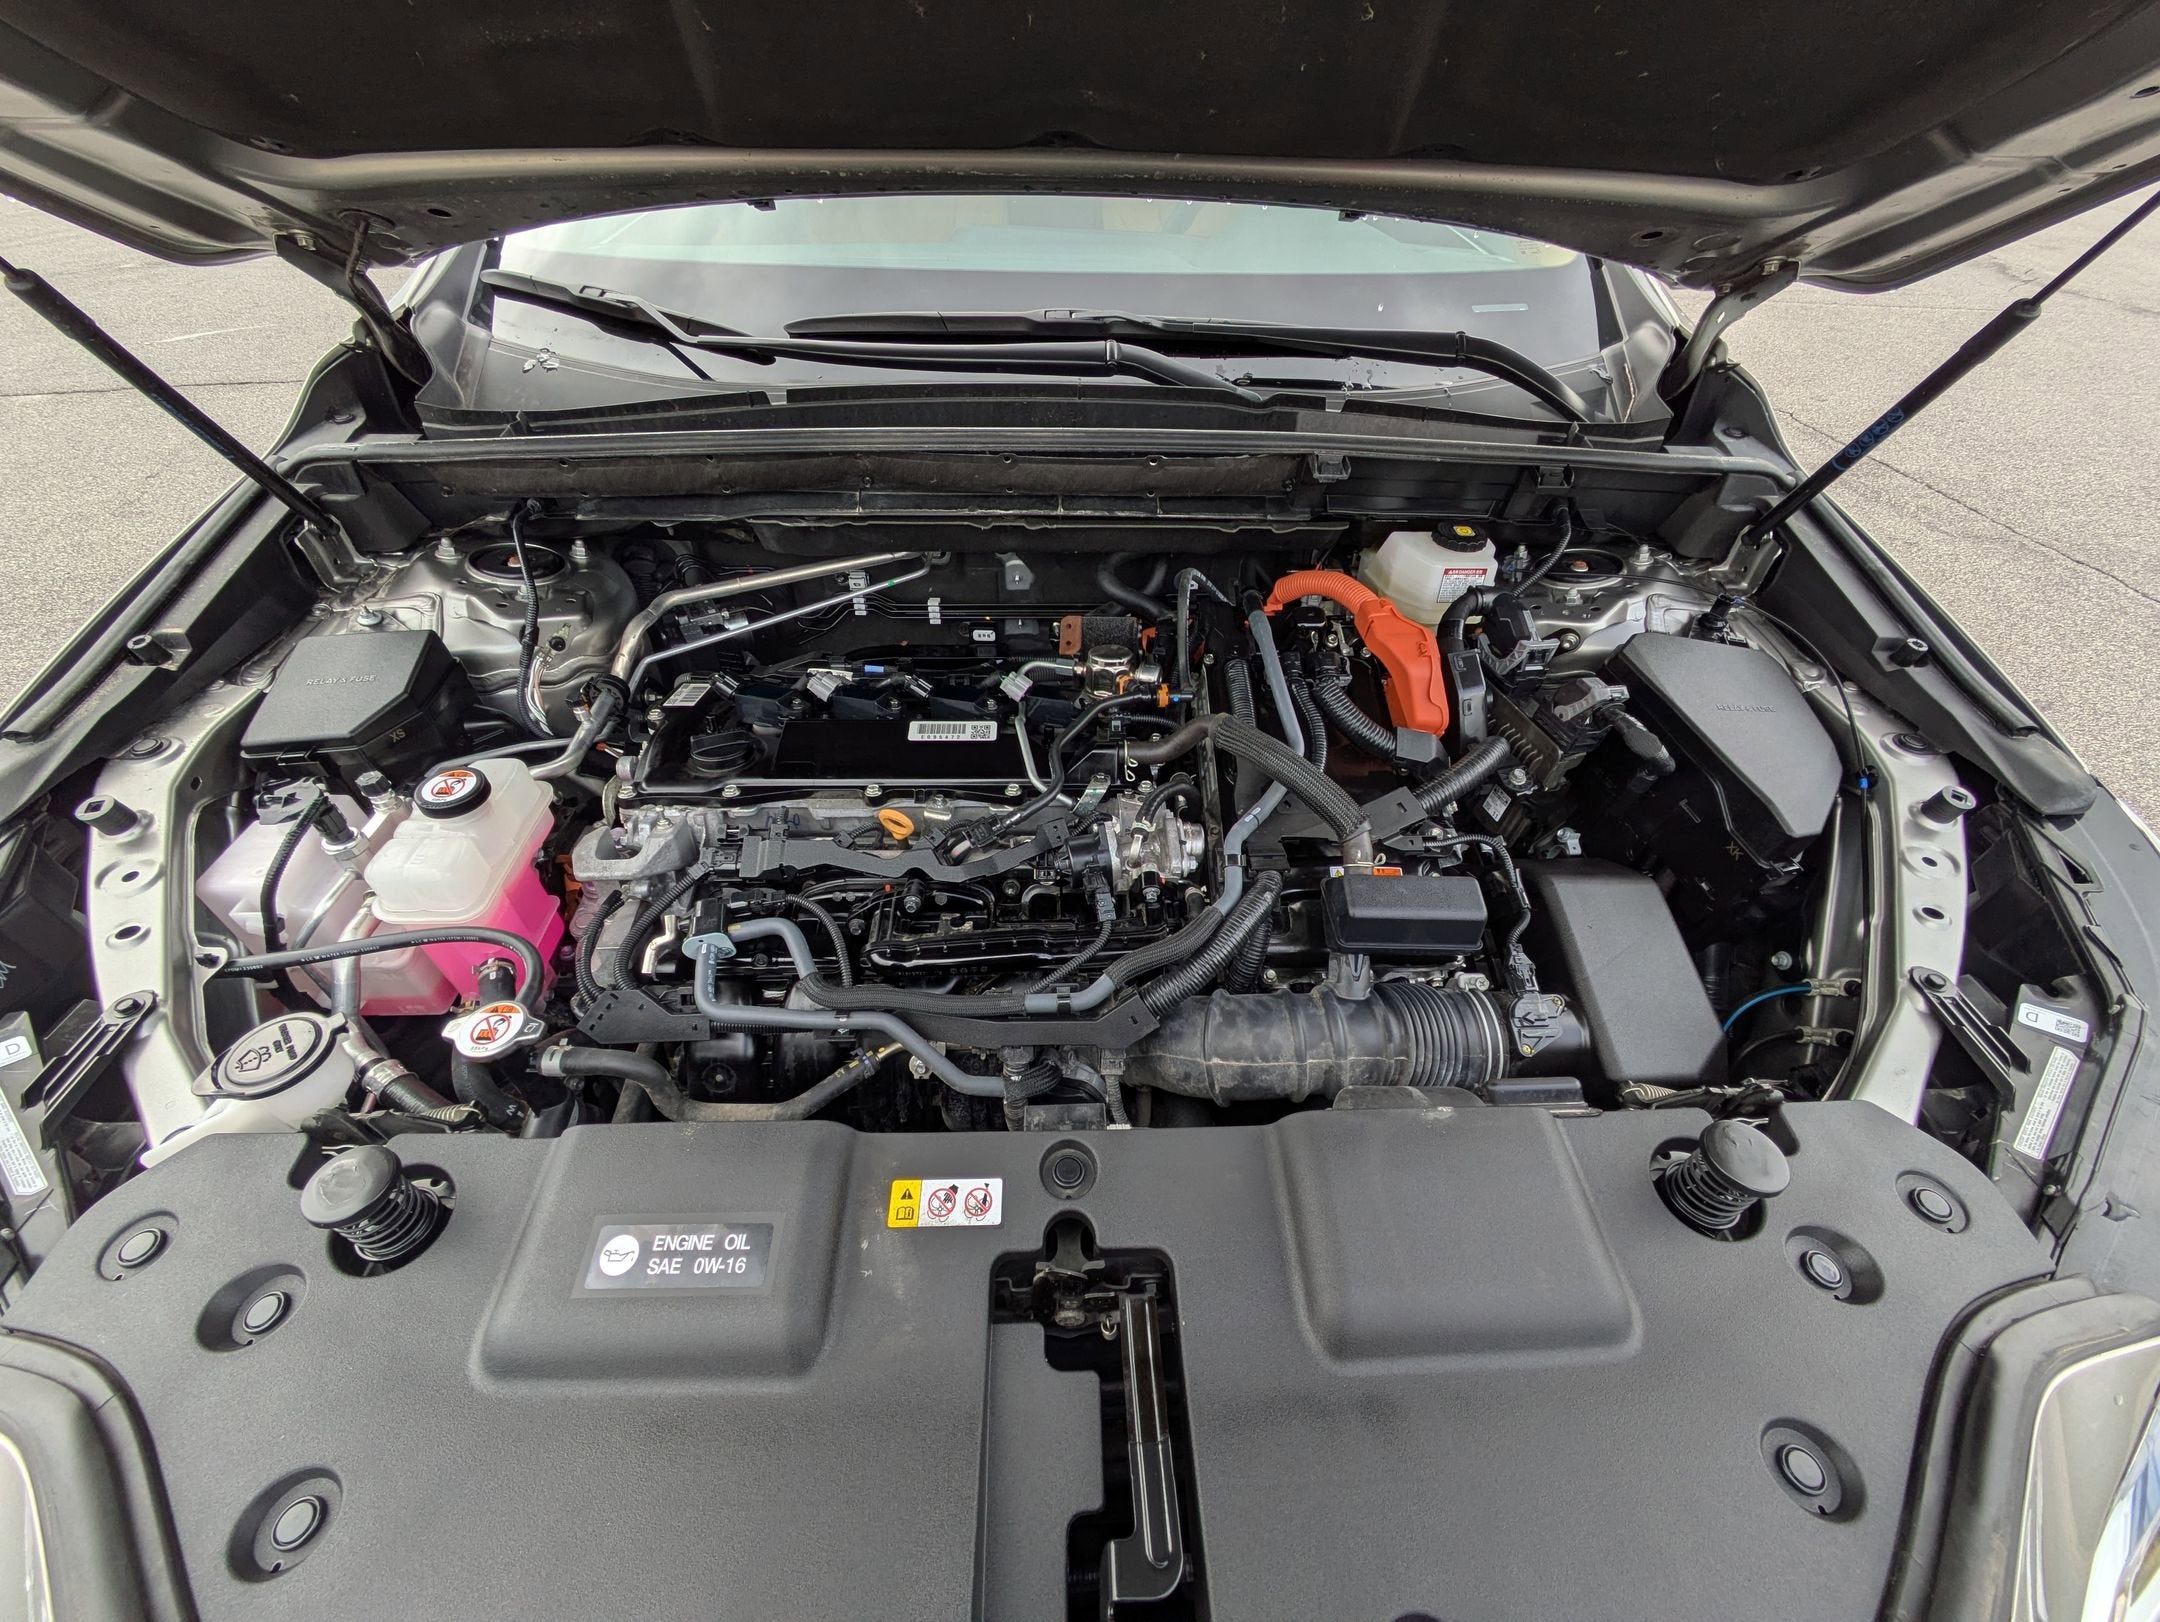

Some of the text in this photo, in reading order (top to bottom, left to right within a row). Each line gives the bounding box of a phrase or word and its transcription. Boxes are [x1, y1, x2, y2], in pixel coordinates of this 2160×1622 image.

[350, 674, 377, 683] FUSE
[388, 728, 406, 743] XS
[5, 1043, 21, 1056] D
[652, 1233, 751, 1251] ENGINE OIL
[646, 1257, 747, 1275] SAE 0W-16
